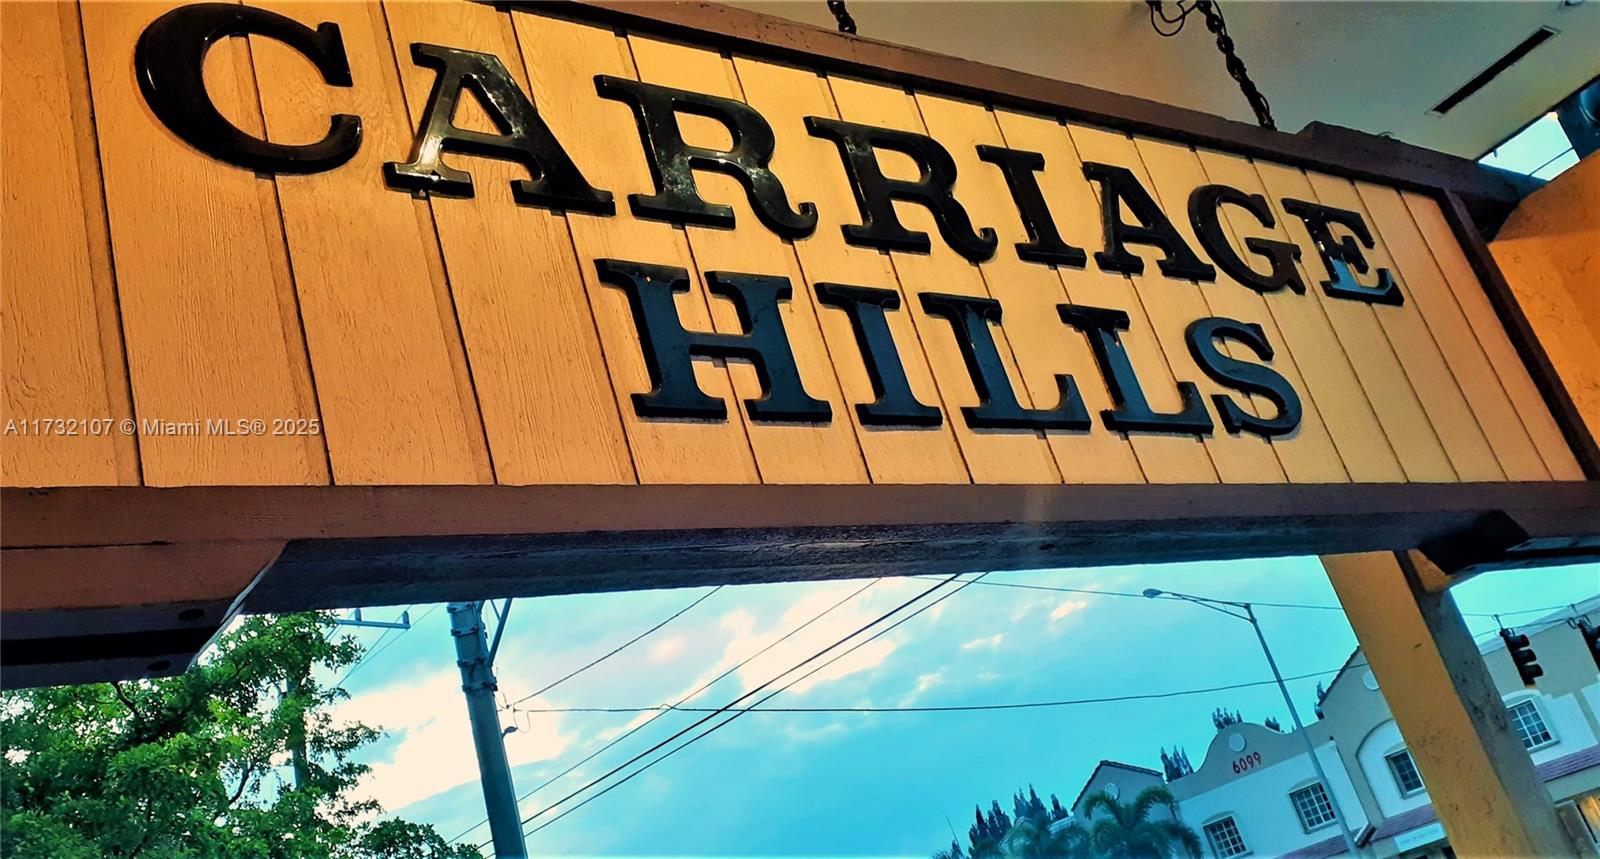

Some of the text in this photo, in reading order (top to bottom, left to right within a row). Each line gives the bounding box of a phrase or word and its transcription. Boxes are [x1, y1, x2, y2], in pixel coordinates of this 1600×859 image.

[135, 3, 1404, 306] CARRIAGE
[594, 258, 1302, 436] HILLS
[1232, 751, 1262, 774] 6099
